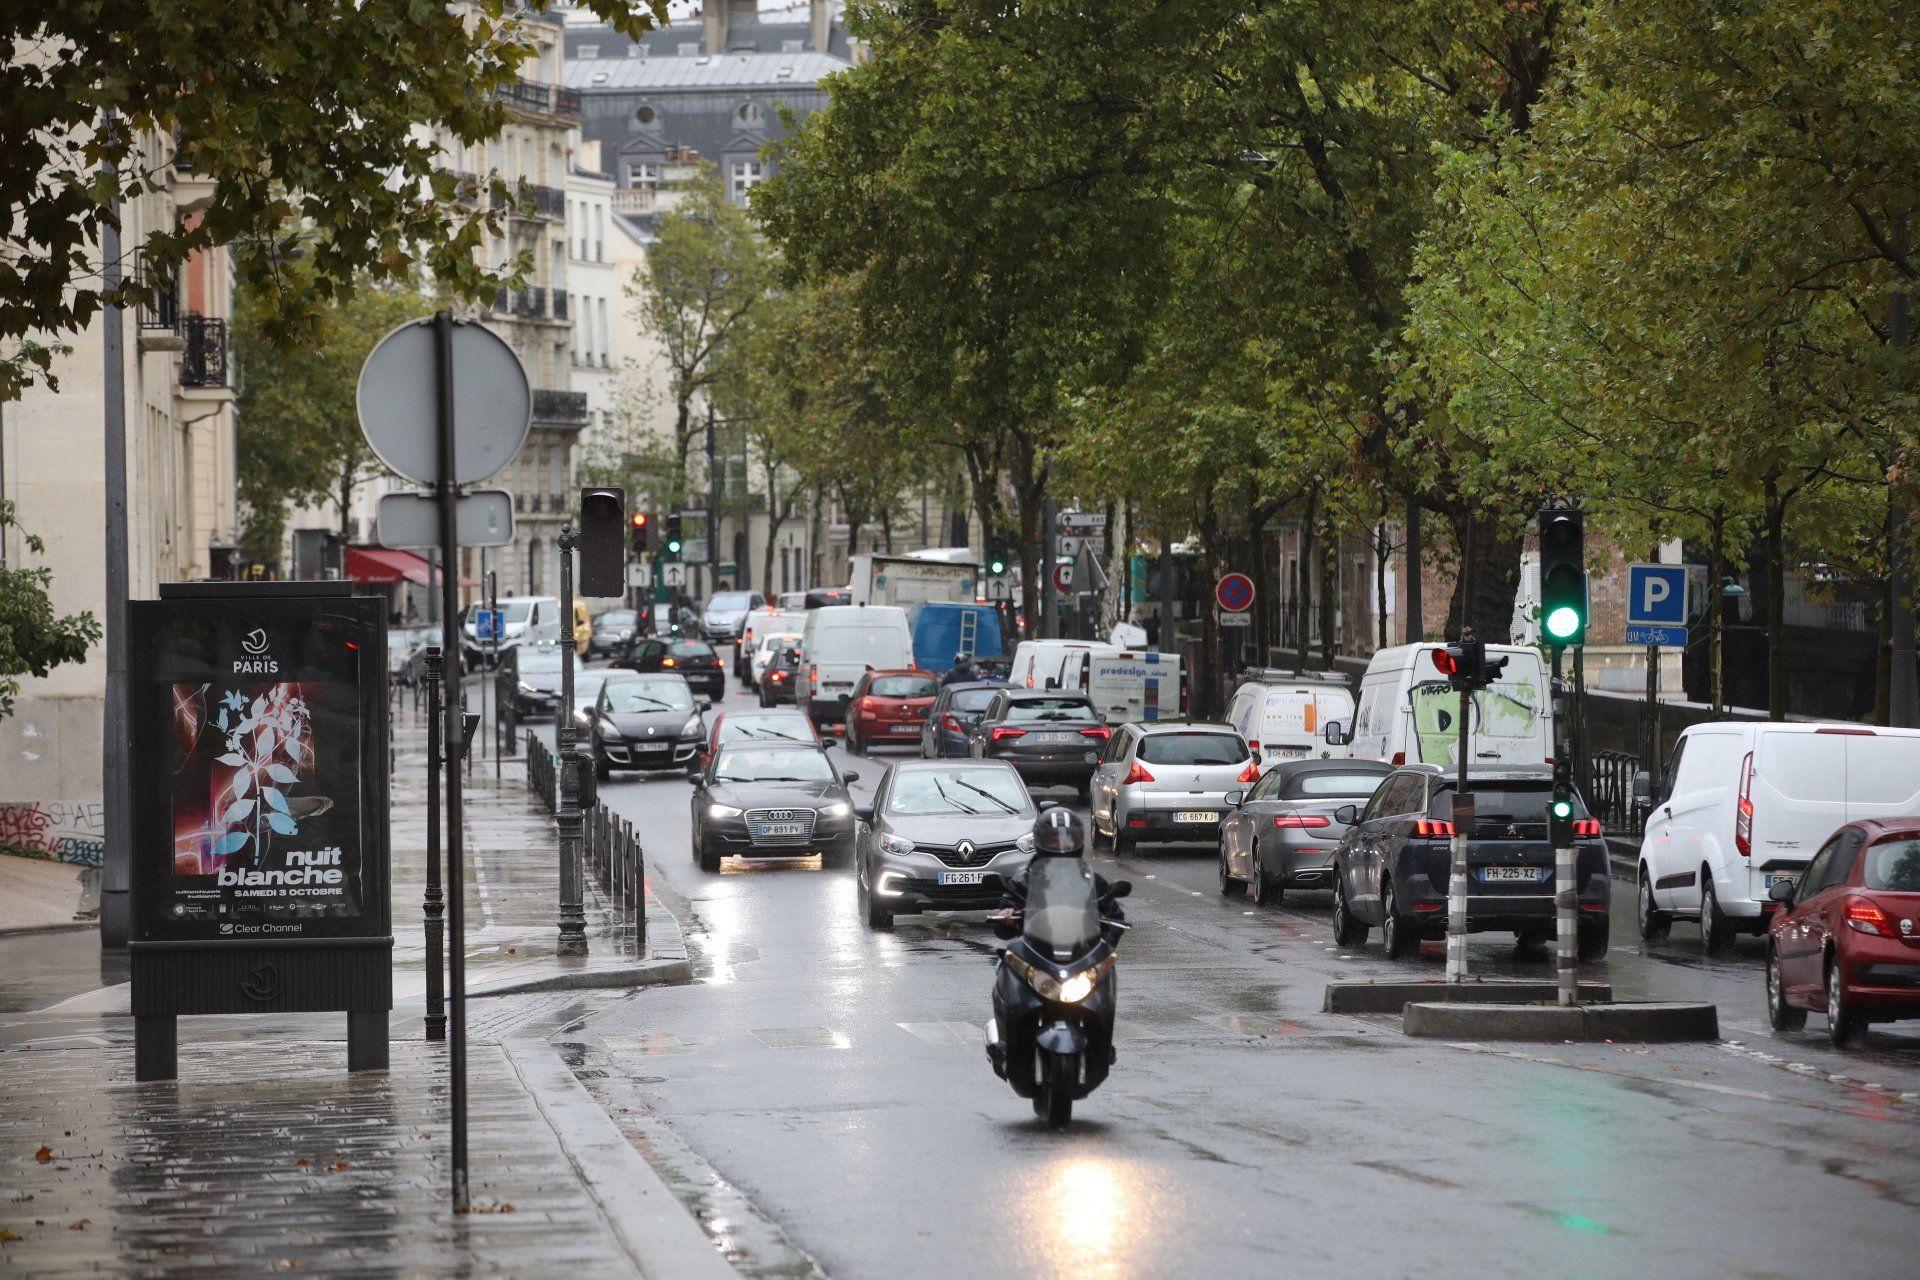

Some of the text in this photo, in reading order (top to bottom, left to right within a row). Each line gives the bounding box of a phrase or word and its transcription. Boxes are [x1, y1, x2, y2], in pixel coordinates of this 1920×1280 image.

[1643, 576, 1670, 613] P
[233, 660, 279, 674] PARIS
[285, 846, 342, 866] nuit
[217, 865, 343, 887] blanche
[945, 872, 986, 883] FG-261-F
[1486, 868, 1536, 879] FH-225-XZ
[234, 887, 343, 898] SAMEDI 3 OCTOBRE
[234, 922, 302, 933] Clear Channel
